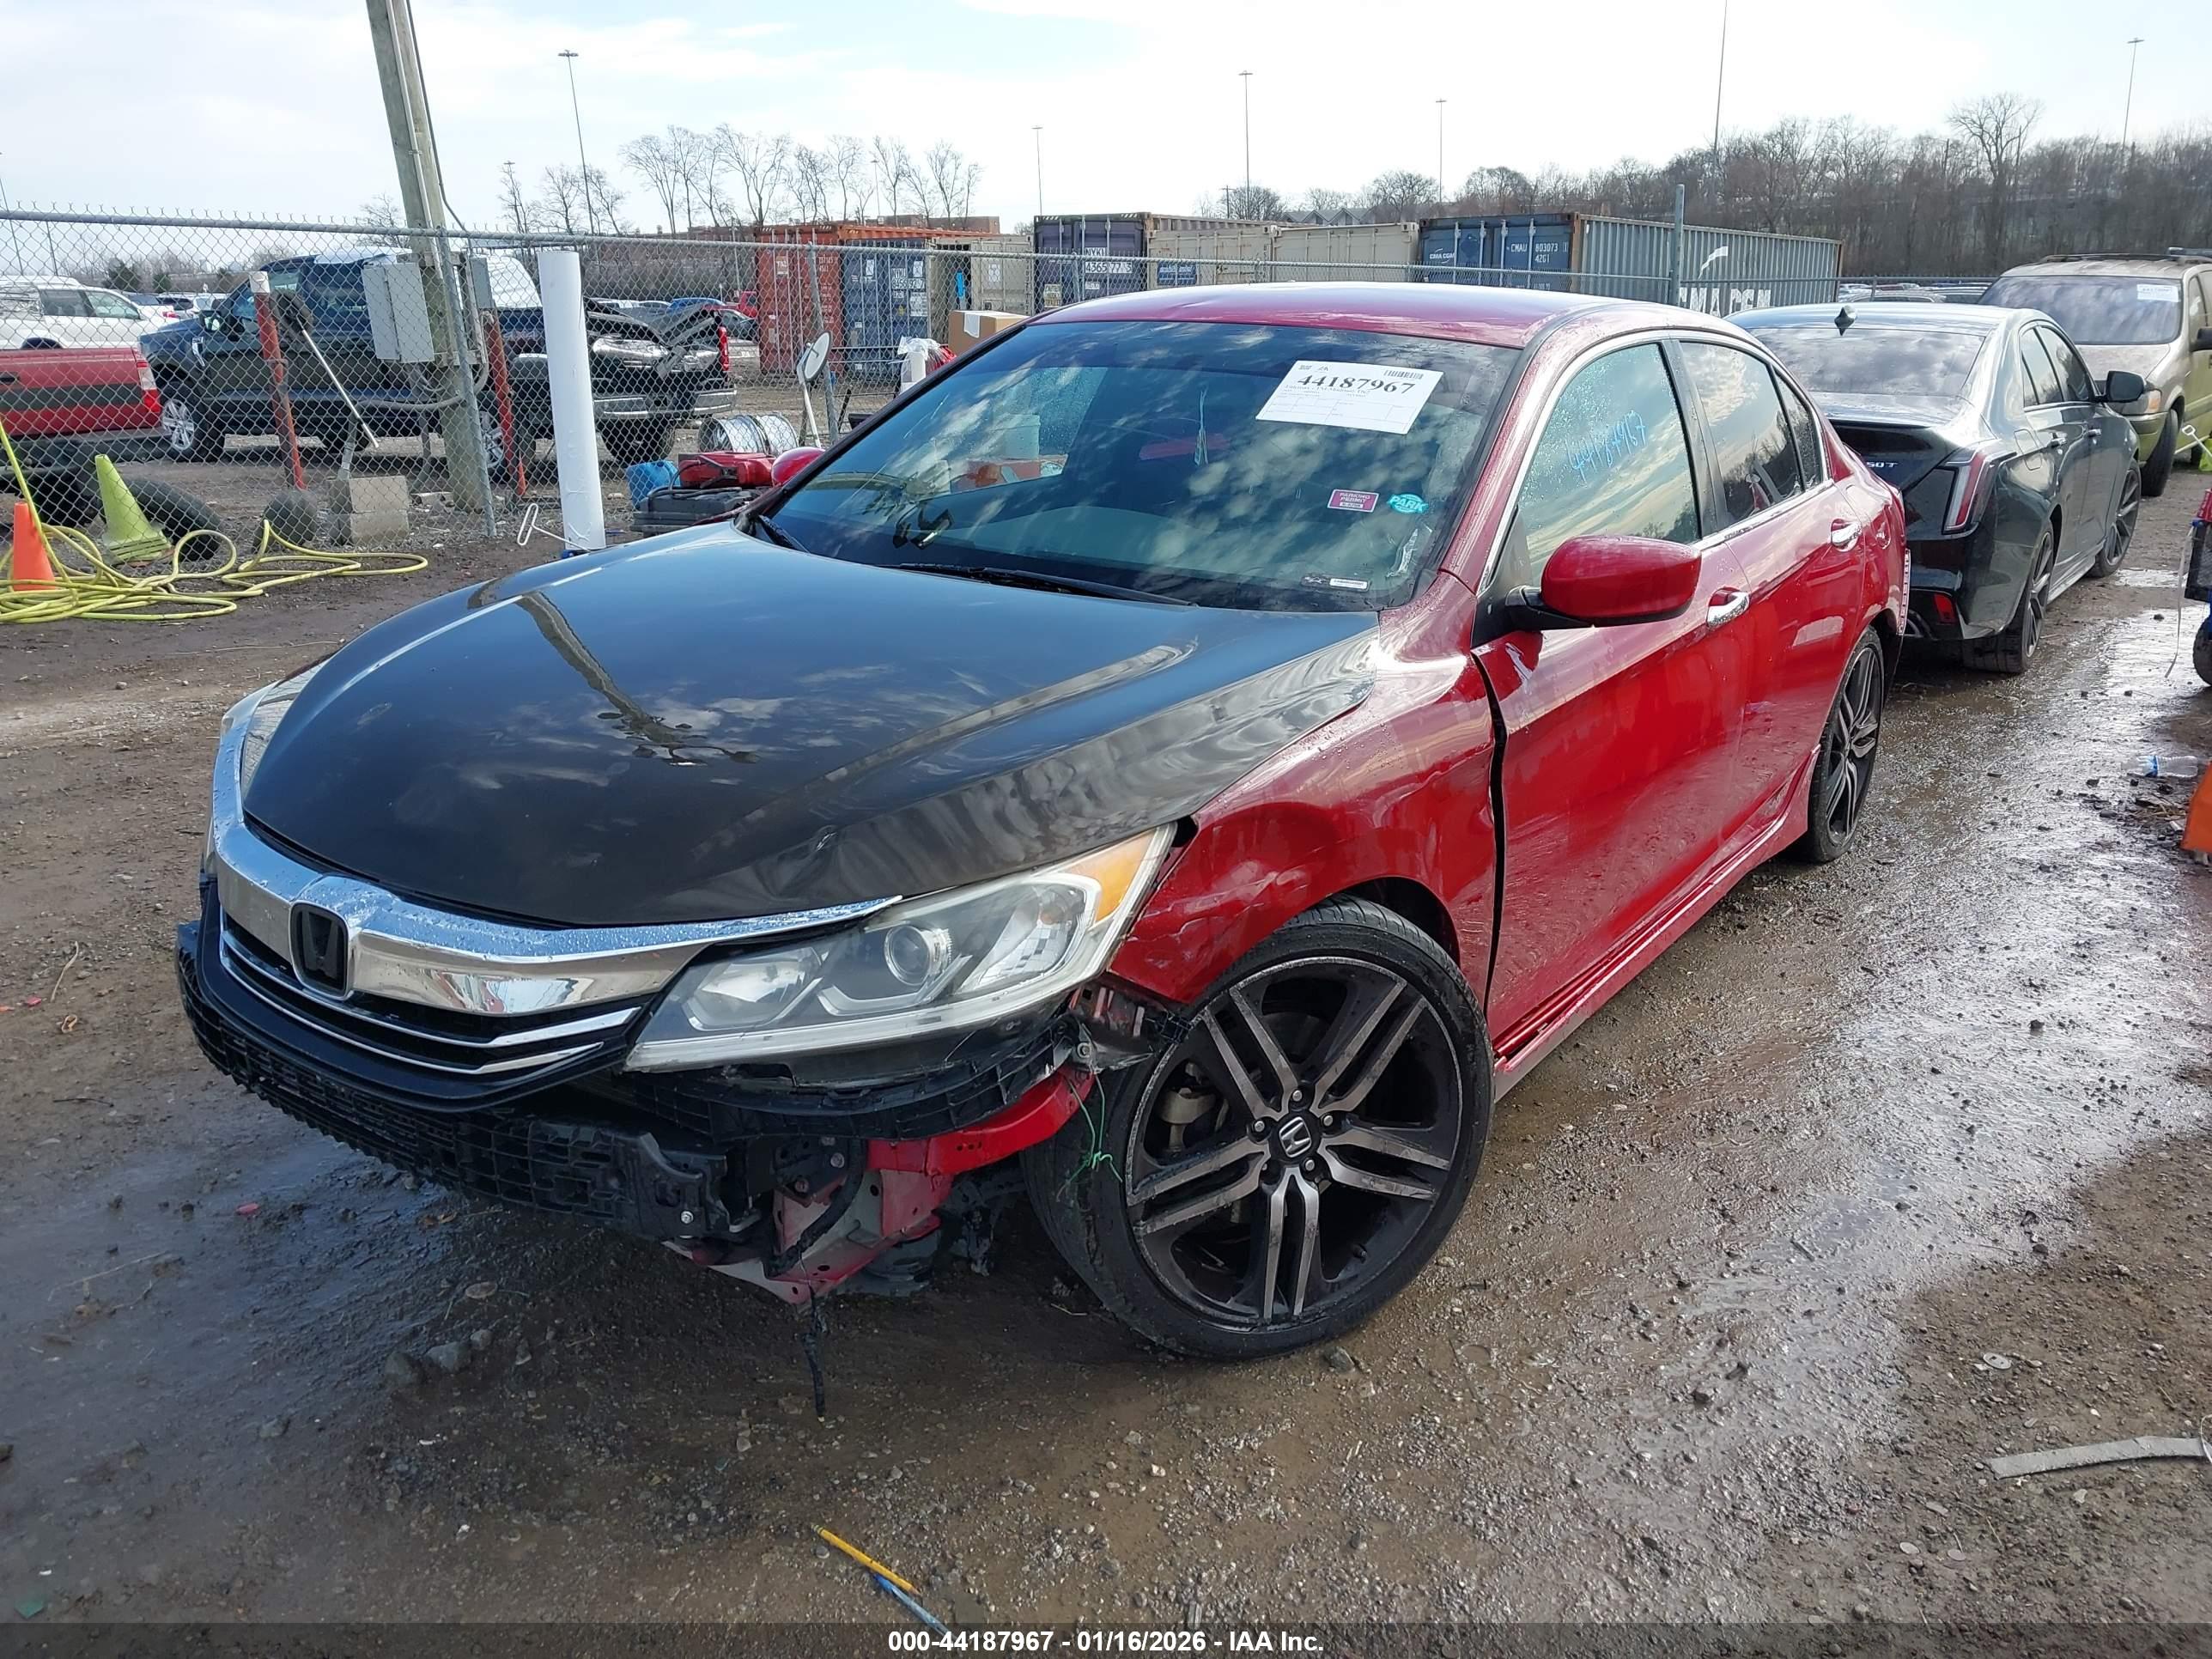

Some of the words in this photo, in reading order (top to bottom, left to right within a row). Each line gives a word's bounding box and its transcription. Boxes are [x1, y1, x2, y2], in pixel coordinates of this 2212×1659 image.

[1510, 242, 1528, 253] CMAU
[1534, 243, 1559, 252] 803073
[1297, 374, 1416, 395] 44187967
[1388, 495, 1429, 513] PARK
